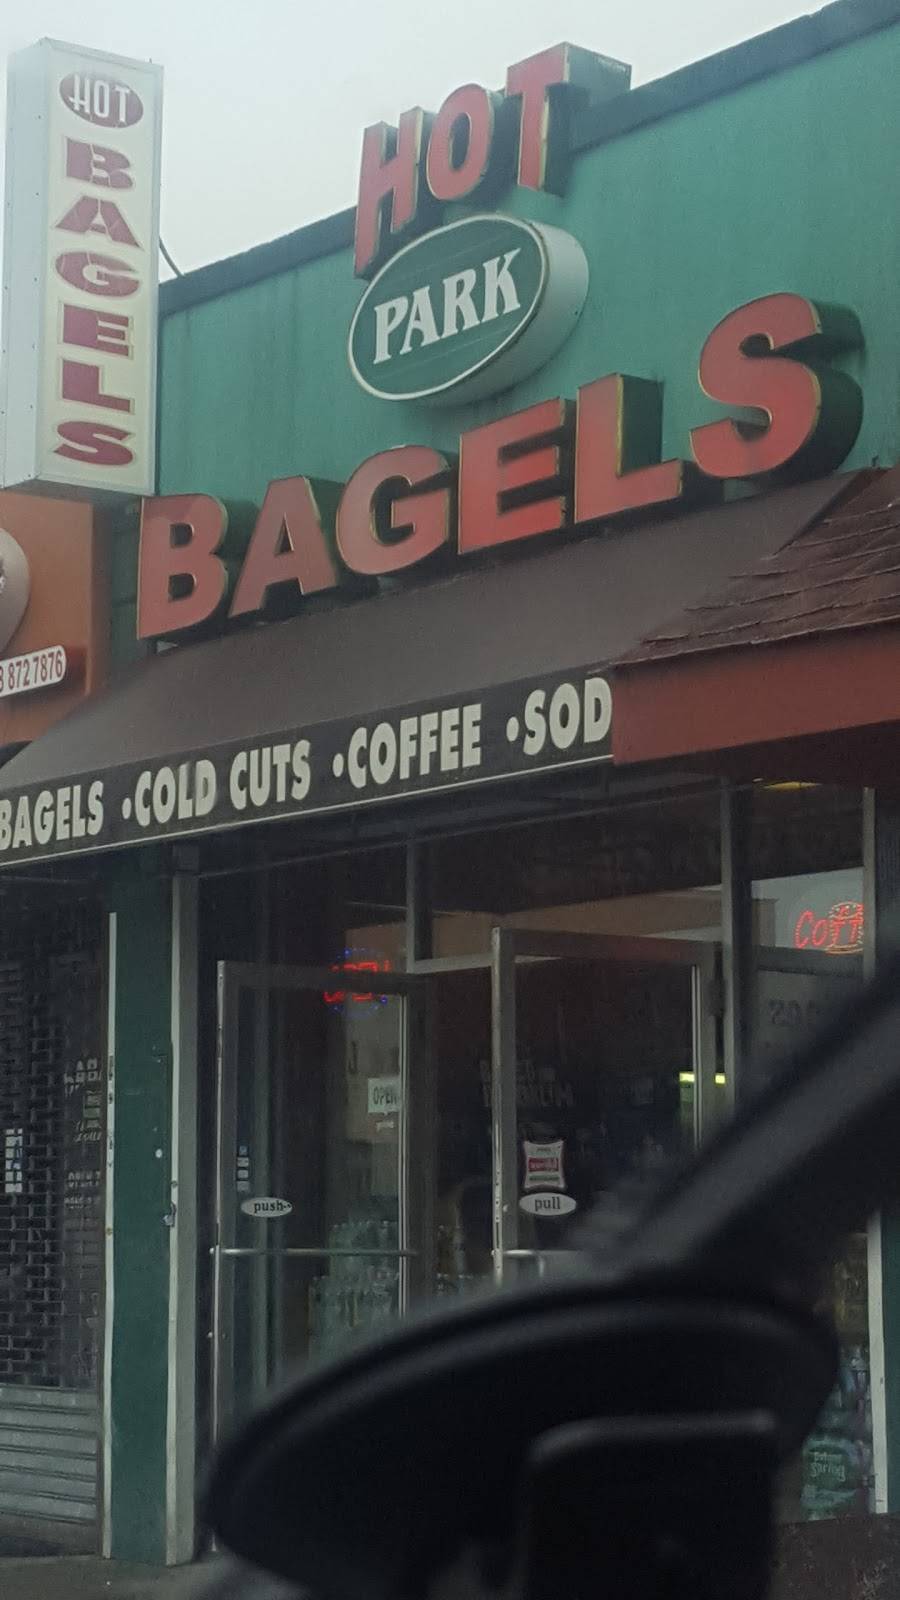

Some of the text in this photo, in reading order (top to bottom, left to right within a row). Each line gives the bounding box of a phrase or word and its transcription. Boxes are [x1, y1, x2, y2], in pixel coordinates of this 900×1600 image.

[67, 73, 130, 124] HOT
[354, 42, 571, 278] HOT
[53, 136, 143, 468] BAGELS
[373, 247, 522, 366] PARK
[136, 291, 823, 641] BAGELS
[8, 658, 30, 690] 872
[32, 649, 63, 685] 7876
[0, 676, 613, 851] BAGELS COLD CUTS COFFEE SOD
[254, 1199, 284, 1214] push
[535, 1196, 561, 1212] pull
